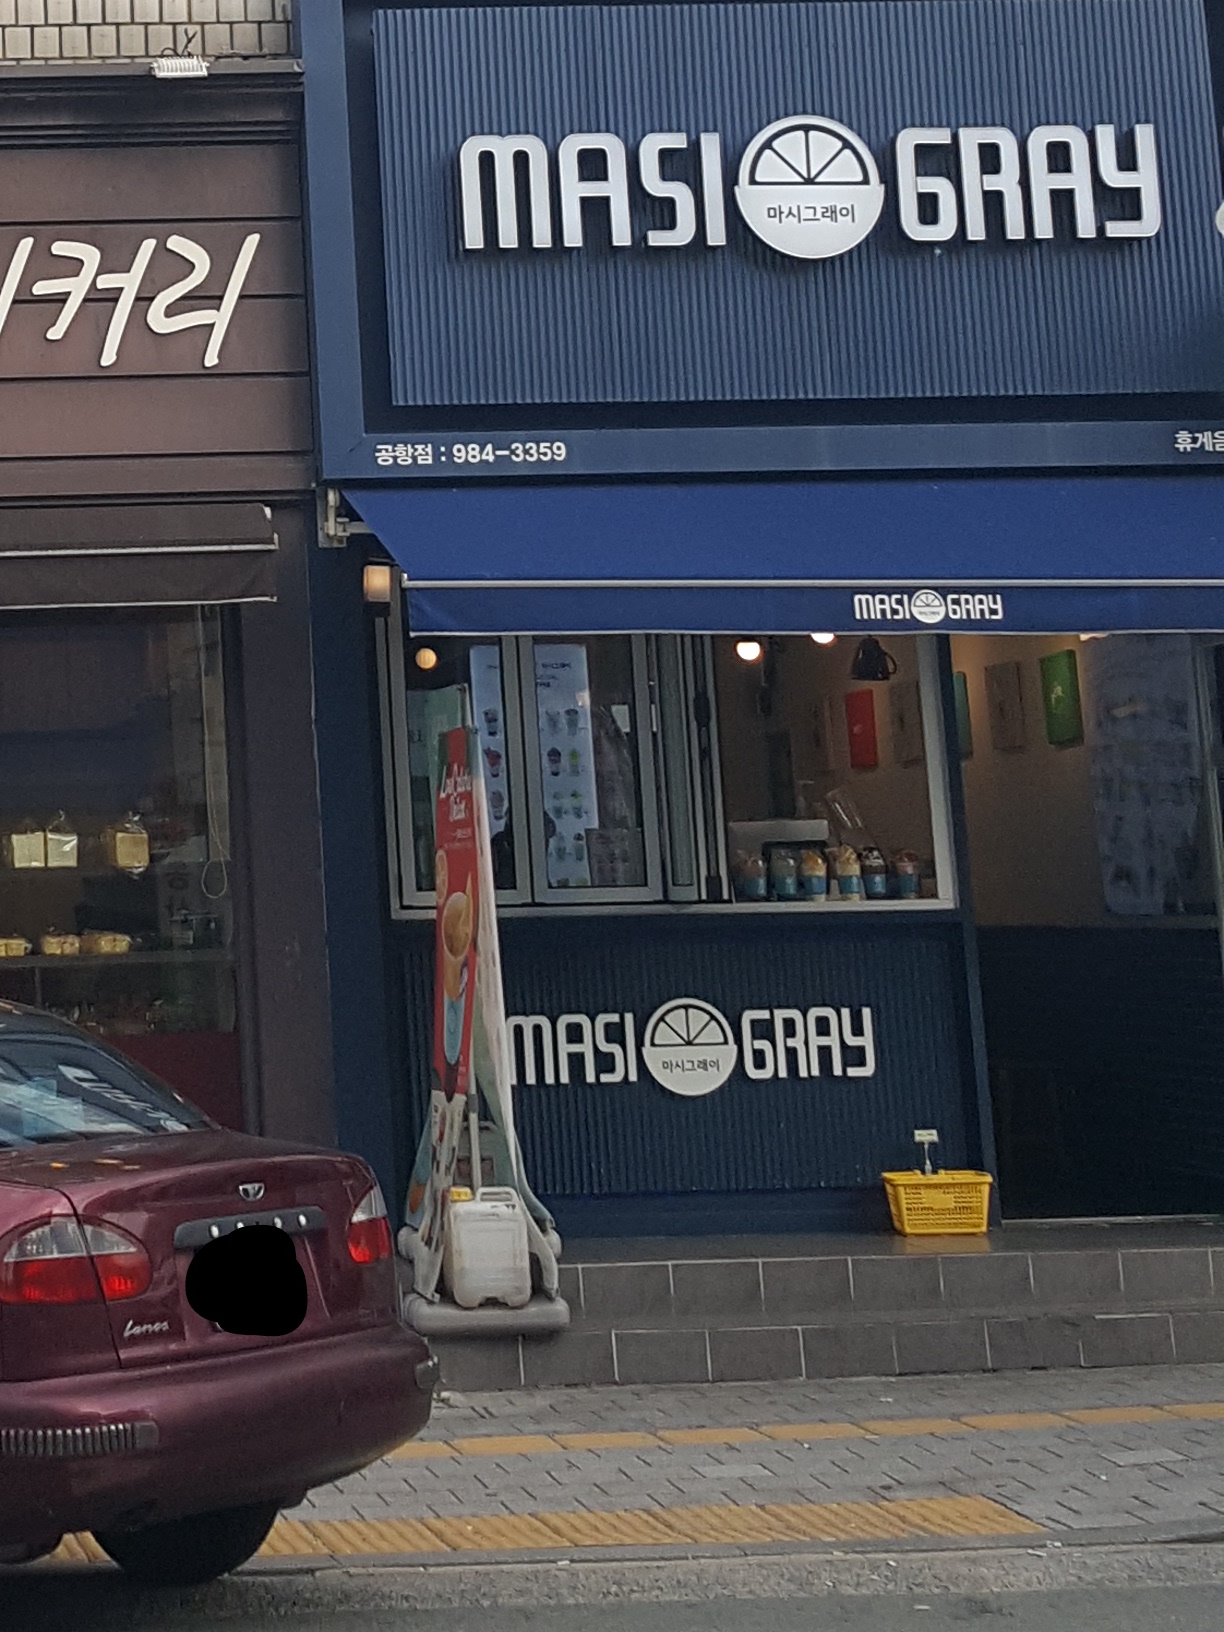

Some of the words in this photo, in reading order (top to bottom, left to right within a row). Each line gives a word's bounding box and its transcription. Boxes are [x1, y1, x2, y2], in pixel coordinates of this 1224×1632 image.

[460, 132, 727, 250] MASI
[895, 124, 1162, 241] GRAY
[766, 203, 856, 224] 마시그래이
[375, 443, 433, 466] 공항점
[452, 441, 567, 464] 984-3359
[853, 594, 911, 620] MASI
[946, 594, 1004, 620] GRAY
[505, 1011, 638, 1086] MASI
[741, 1006, 877, 1080] GRAY
